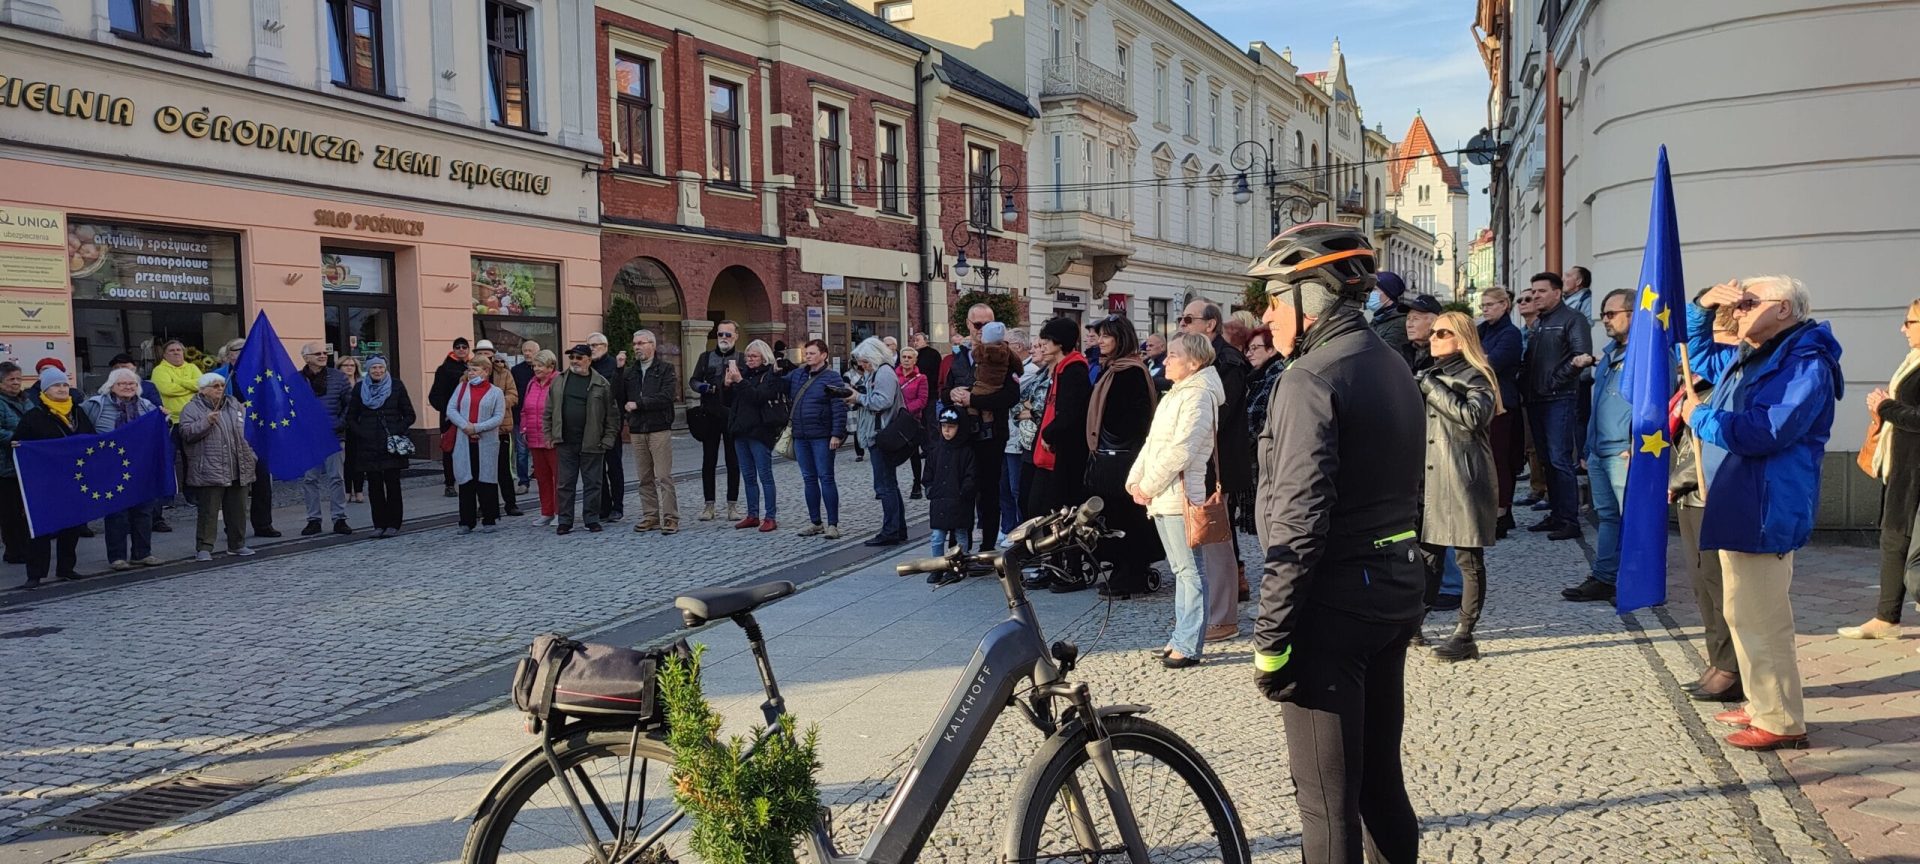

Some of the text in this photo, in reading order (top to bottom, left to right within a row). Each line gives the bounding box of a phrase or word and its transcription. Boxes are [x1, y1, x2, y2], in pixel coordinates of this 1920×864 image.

[154, 105, 361, 163] OGRODNICZA
[373, 145, 441, 178] ZIEMI
[450, 160, 551, 196] SĄDECKIEJ
[17, 216, 59, 229] UNIQA
[314, 209, 352, 229] SKLEP
[3, 231, 50, 241] ubezpieczenia
[94, 233, 208, 253] artykuły spożywcze
[136, 254, 208, 269] monopolowe
[135, 271, 209, 286] przemysłowe
[109, 286, 211, 304] owoce i warzywa
[1114, 299, 1125, 310] M
[943, 665, 991, 742] KALKHOFF
